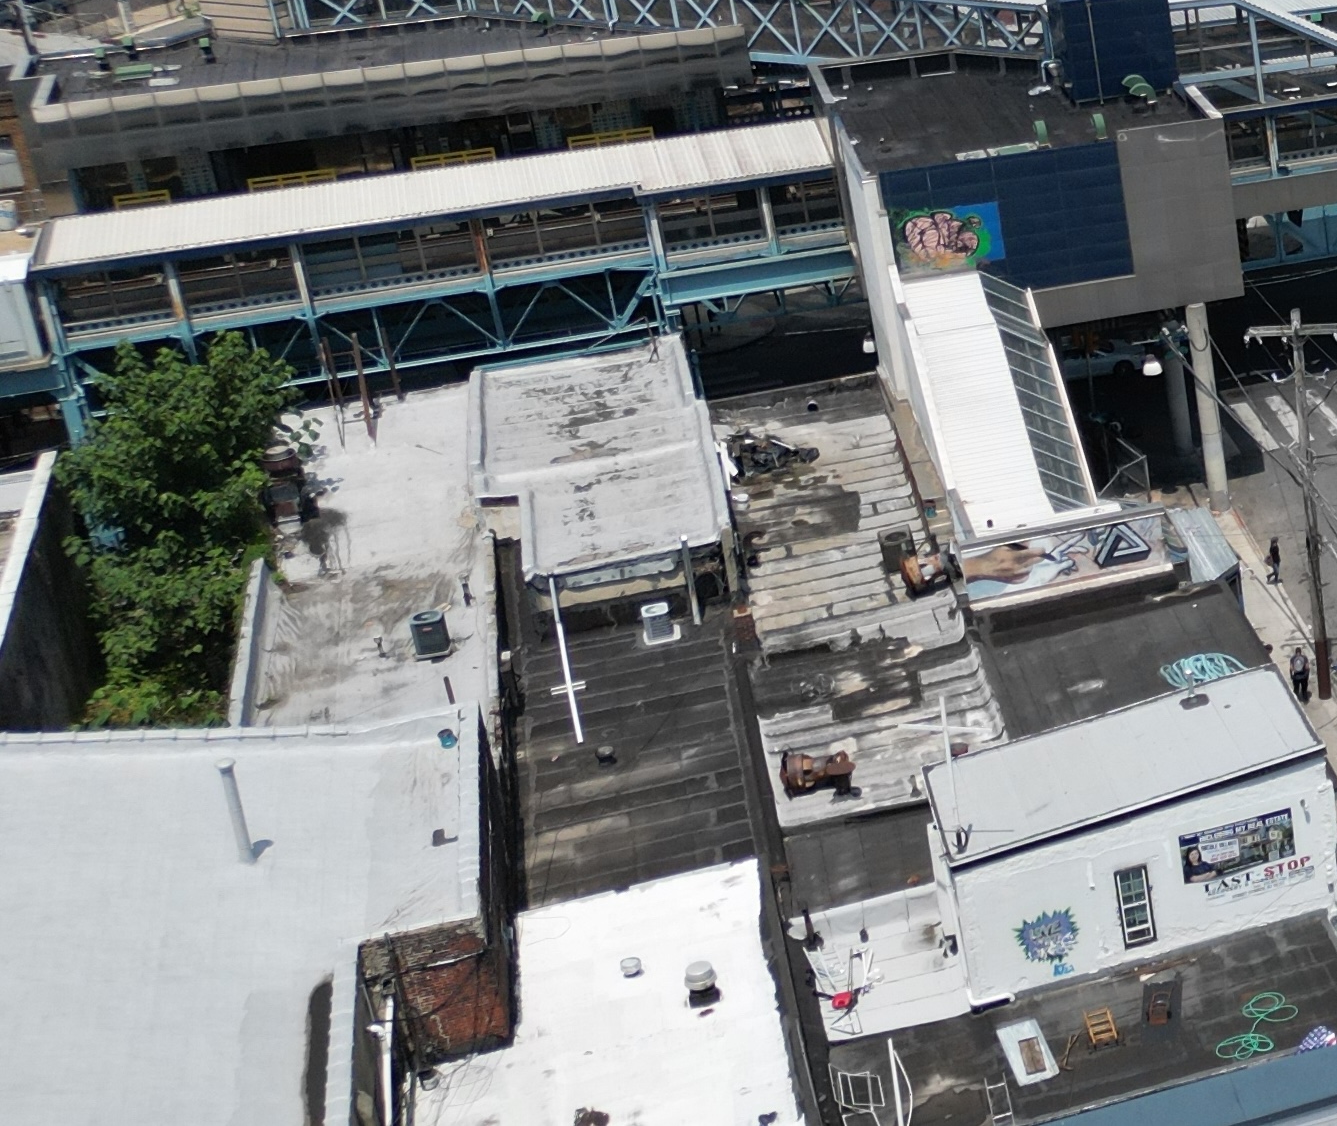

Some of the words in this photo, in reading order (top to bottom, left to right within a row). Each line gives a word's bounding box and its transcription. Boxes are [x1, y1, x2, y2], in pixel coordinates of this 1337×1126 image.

[1235, 824, 1247, 834] MY
[1247, 820, 1264, 831] REAL
[1265, 813, 1289, 826] ESTATE
[1204, 871, 1254, 893] LAST
[1264, 855, 1311, 879] STOP
